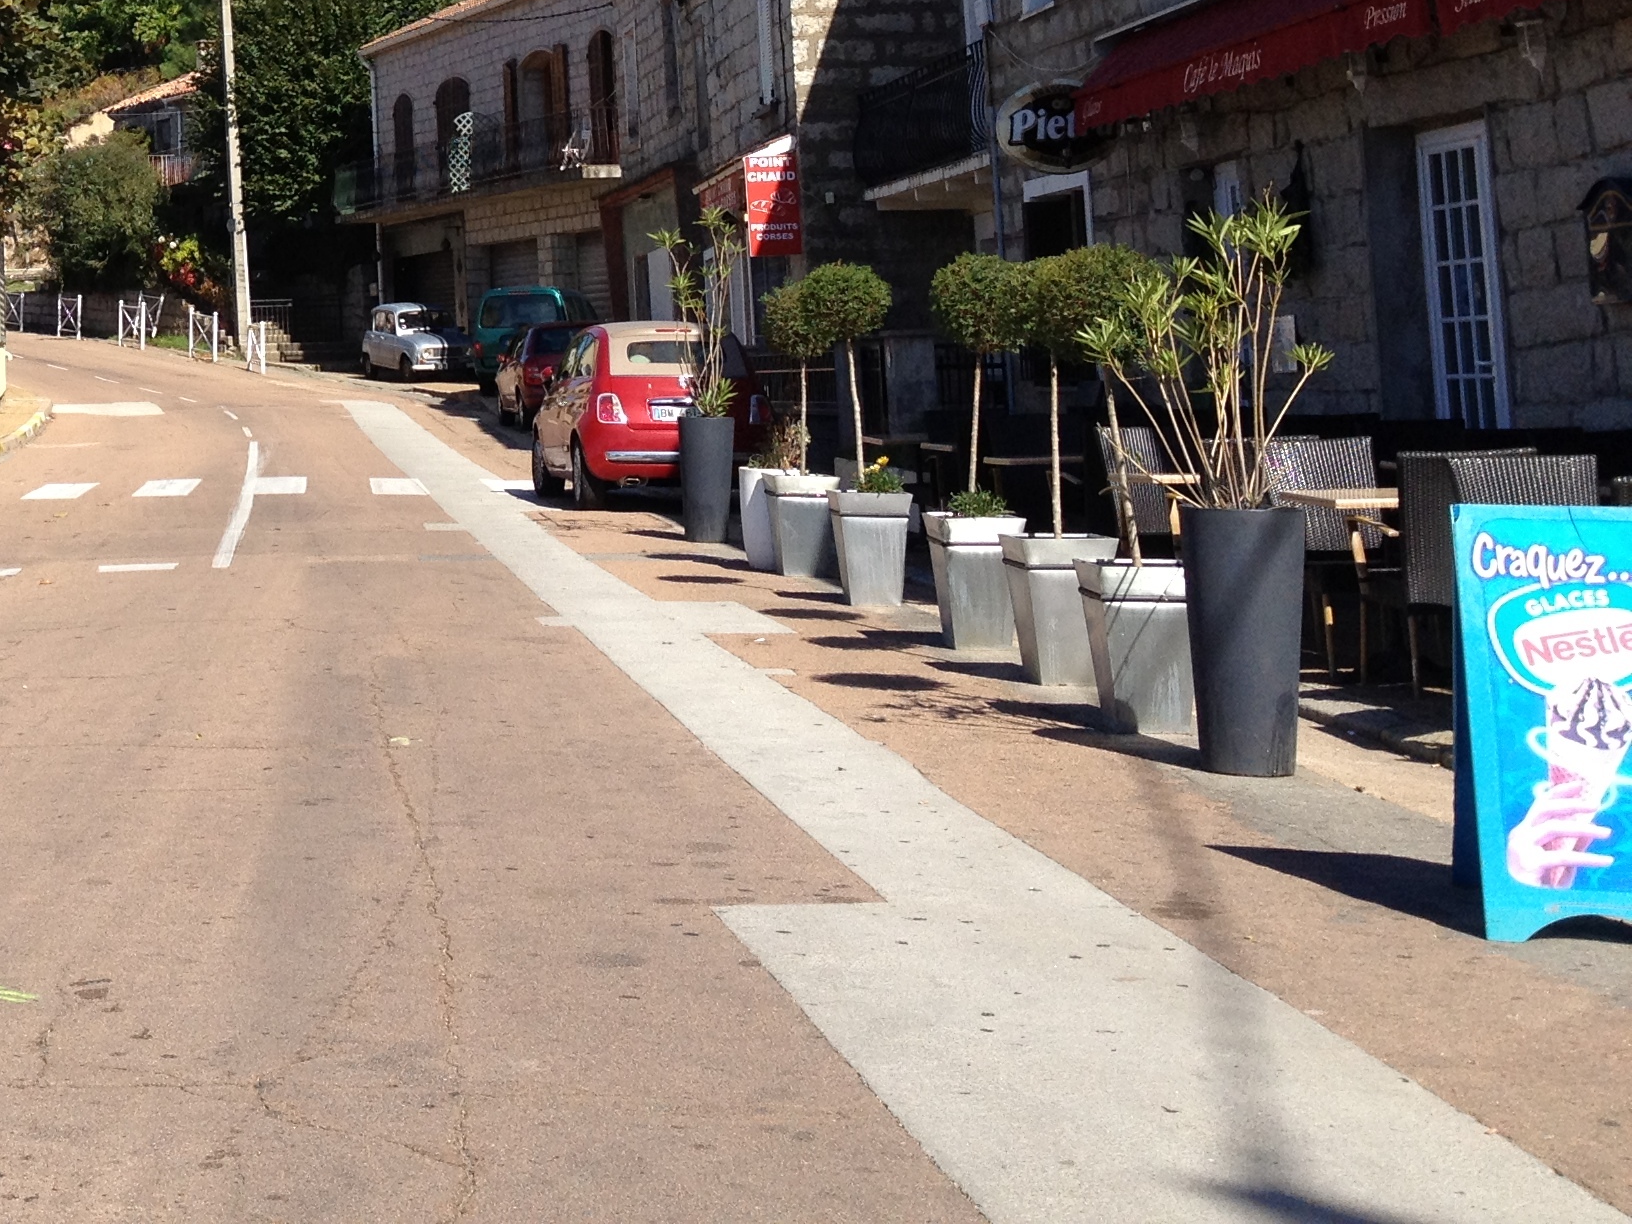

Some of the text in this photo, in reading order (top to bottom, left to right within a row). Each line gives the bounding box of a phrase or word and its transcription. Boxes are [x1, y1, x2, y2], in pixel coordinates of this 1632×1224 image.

[749, 156, 792, 168] POINT
[747, 171, 796, 182] CHAUD
[750, 222, 799, 232] PRODUITS
[756, 232, 794, 241] CORSES
[1524, 589, 1610, 617] GLACES
